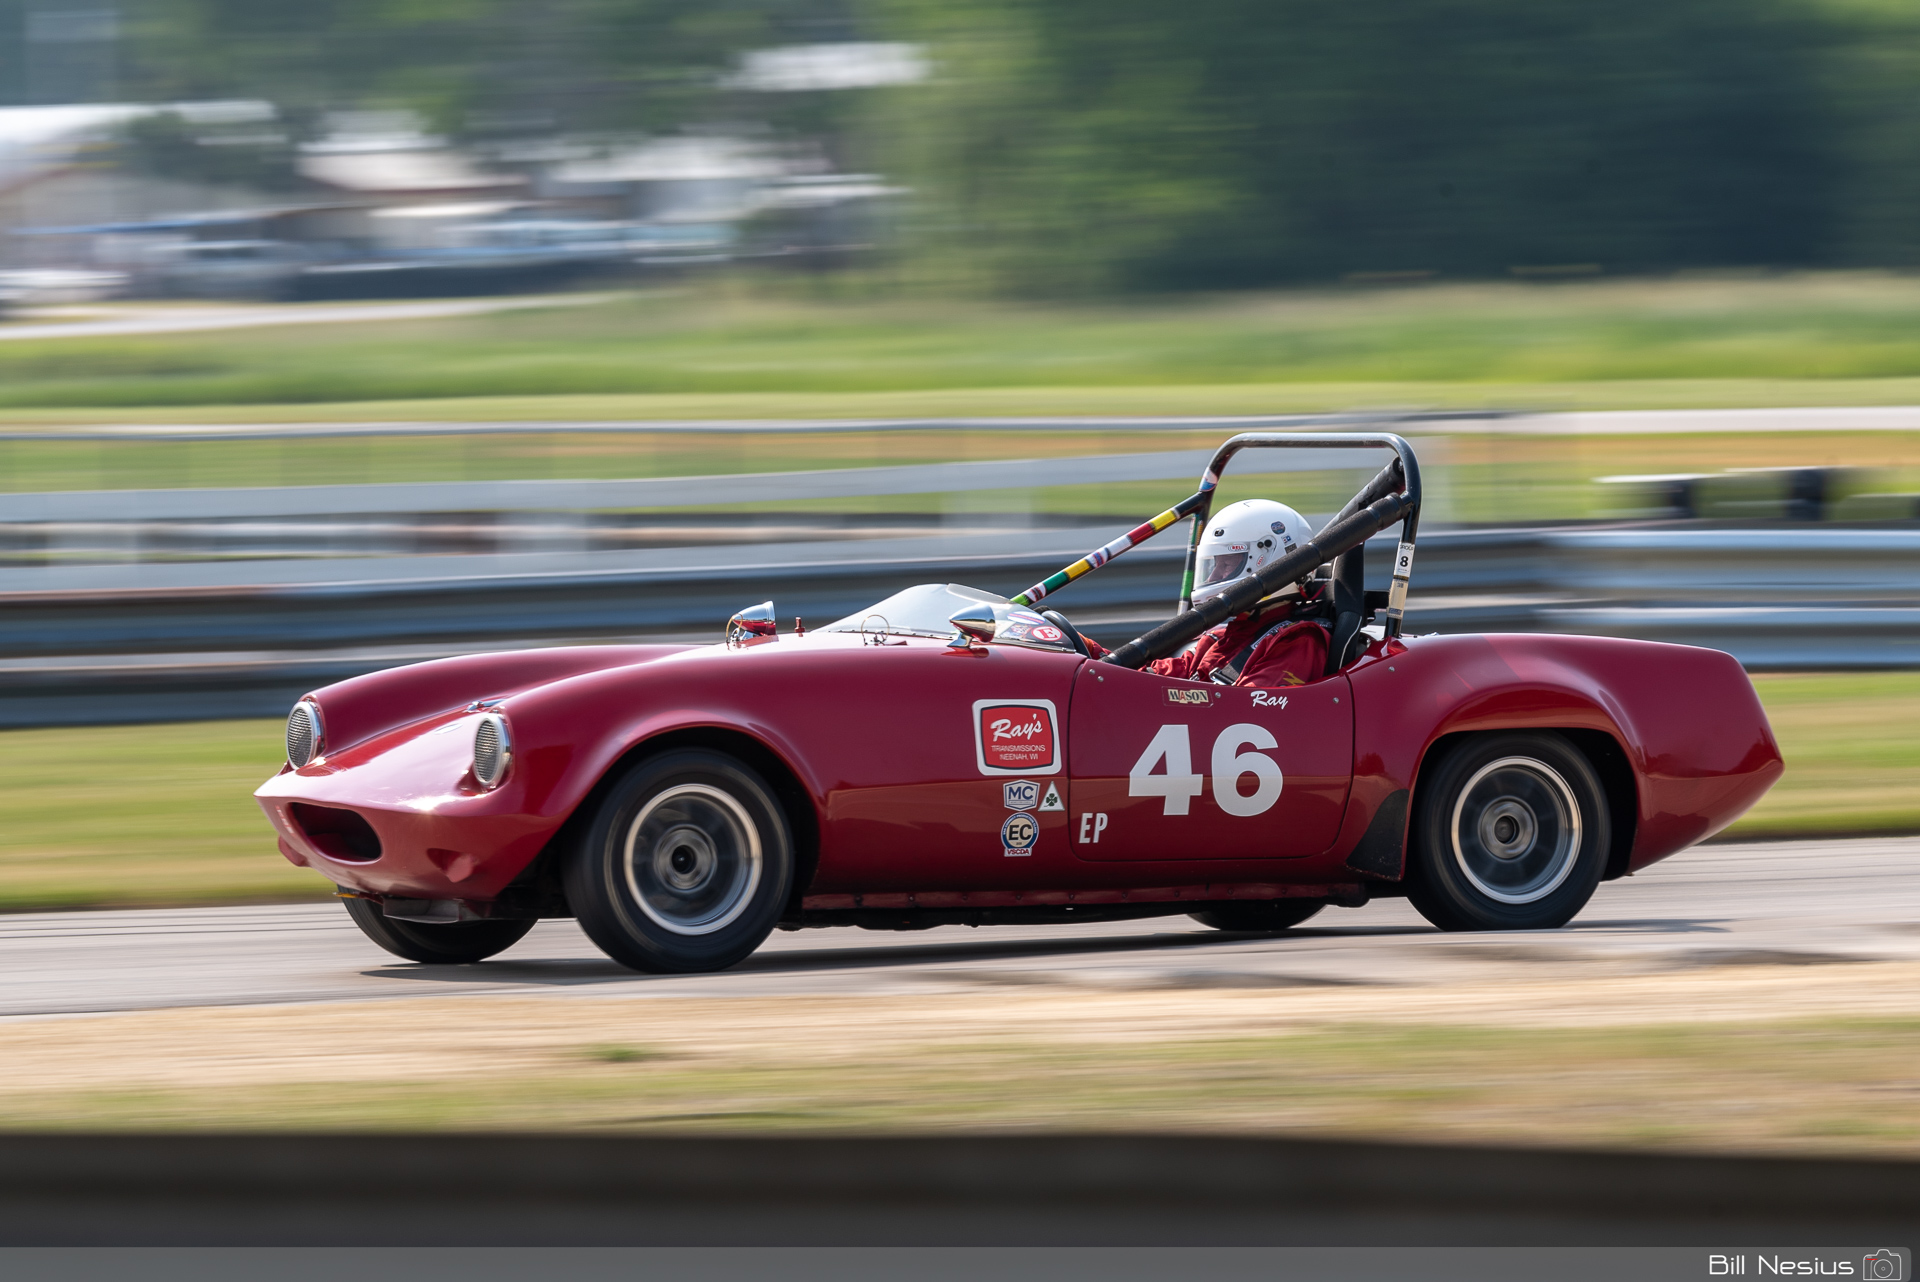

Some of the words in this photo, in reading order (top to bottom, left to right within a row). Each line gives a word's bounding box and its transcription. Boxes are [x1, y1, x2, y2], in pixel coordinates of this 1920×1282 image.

[1400, 556, 1409, 567] 8
[1037, 628, 1058, 639] E
[1169, 690, 1208, 701] MASON
[1250, 690, 1289, 709] Ray
[990, 713, 1043, 742] Ray's
[1128, 723, 1284, 817] 46
[1008, 786, 1034, 800] MC
[1008, 824, 1032, 840] EC
[1079, 812, 1108, 844] EP
